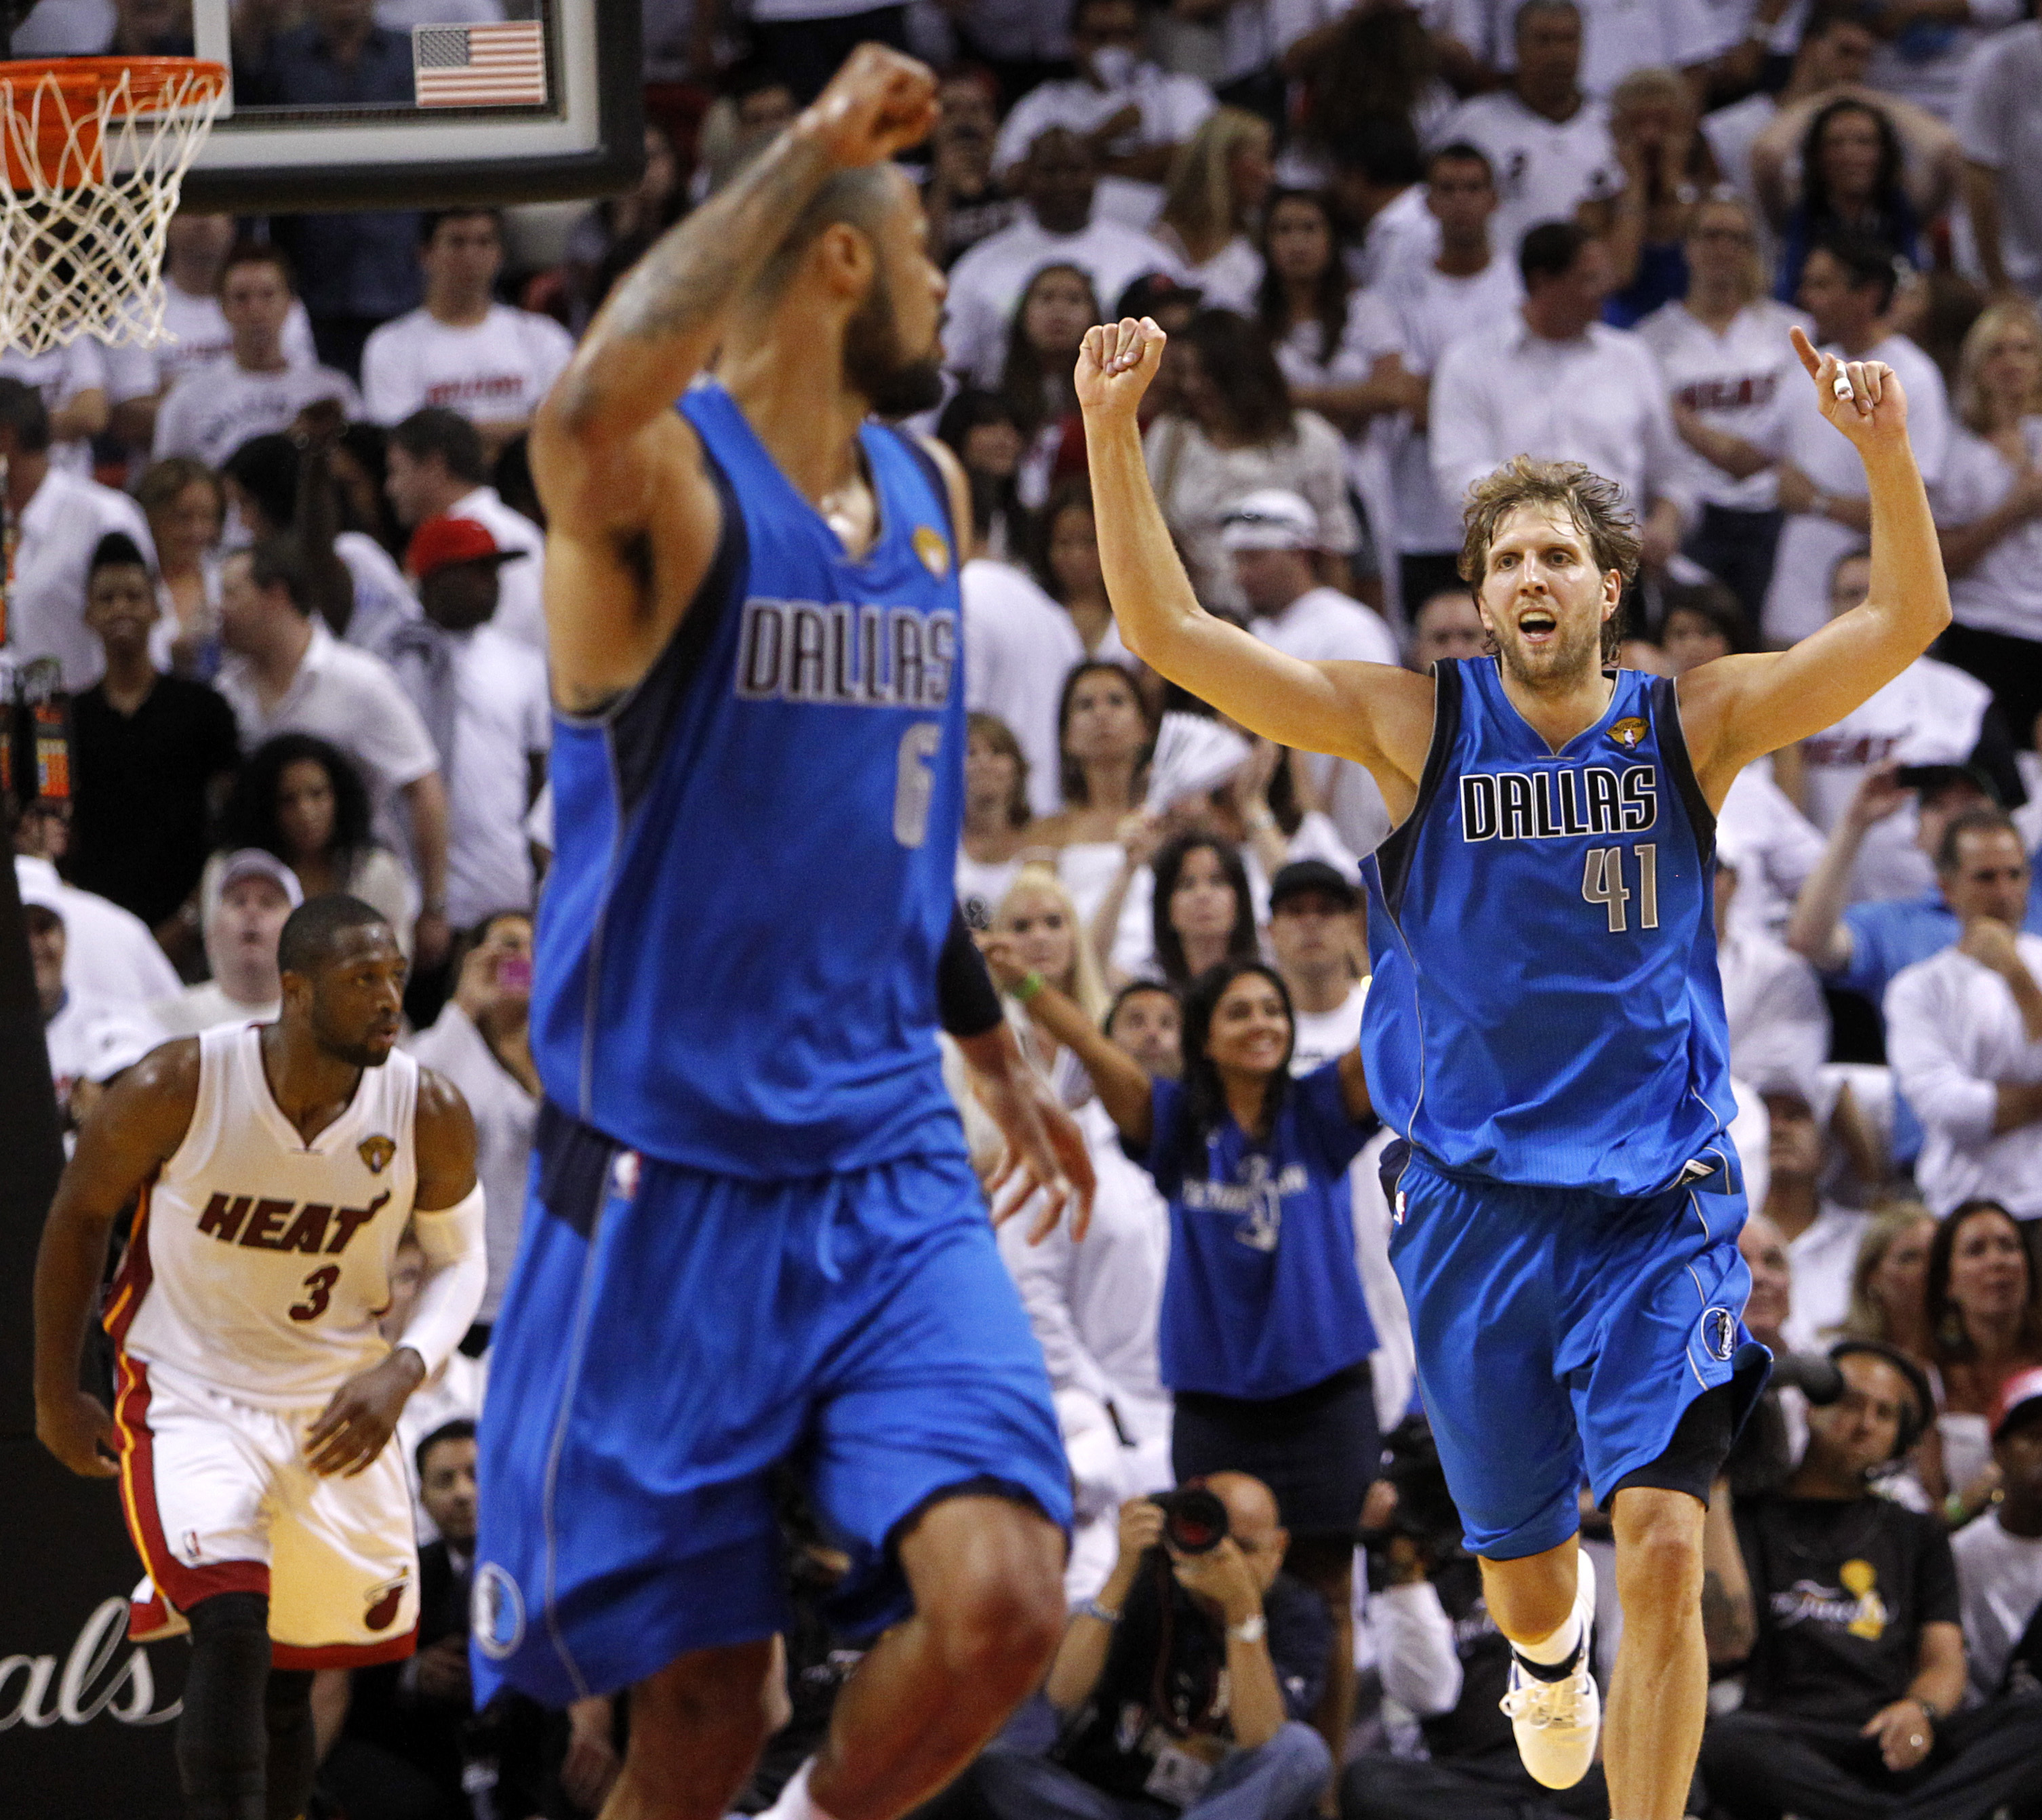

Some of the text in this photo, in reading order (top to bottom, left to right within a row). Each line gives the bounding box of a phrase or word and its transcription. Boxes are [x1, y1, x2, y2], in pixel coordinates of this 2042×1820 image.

[735, 597, 957, 711] DALLAS
[893, 721, 943, 849] 6
[1459, 765, 1658, 843] DALLAS
[1582, 844, 1659, 932] 41
[197, 1189, 391, 1254] HEAT
[289, 1264, 340, 1321] 3
